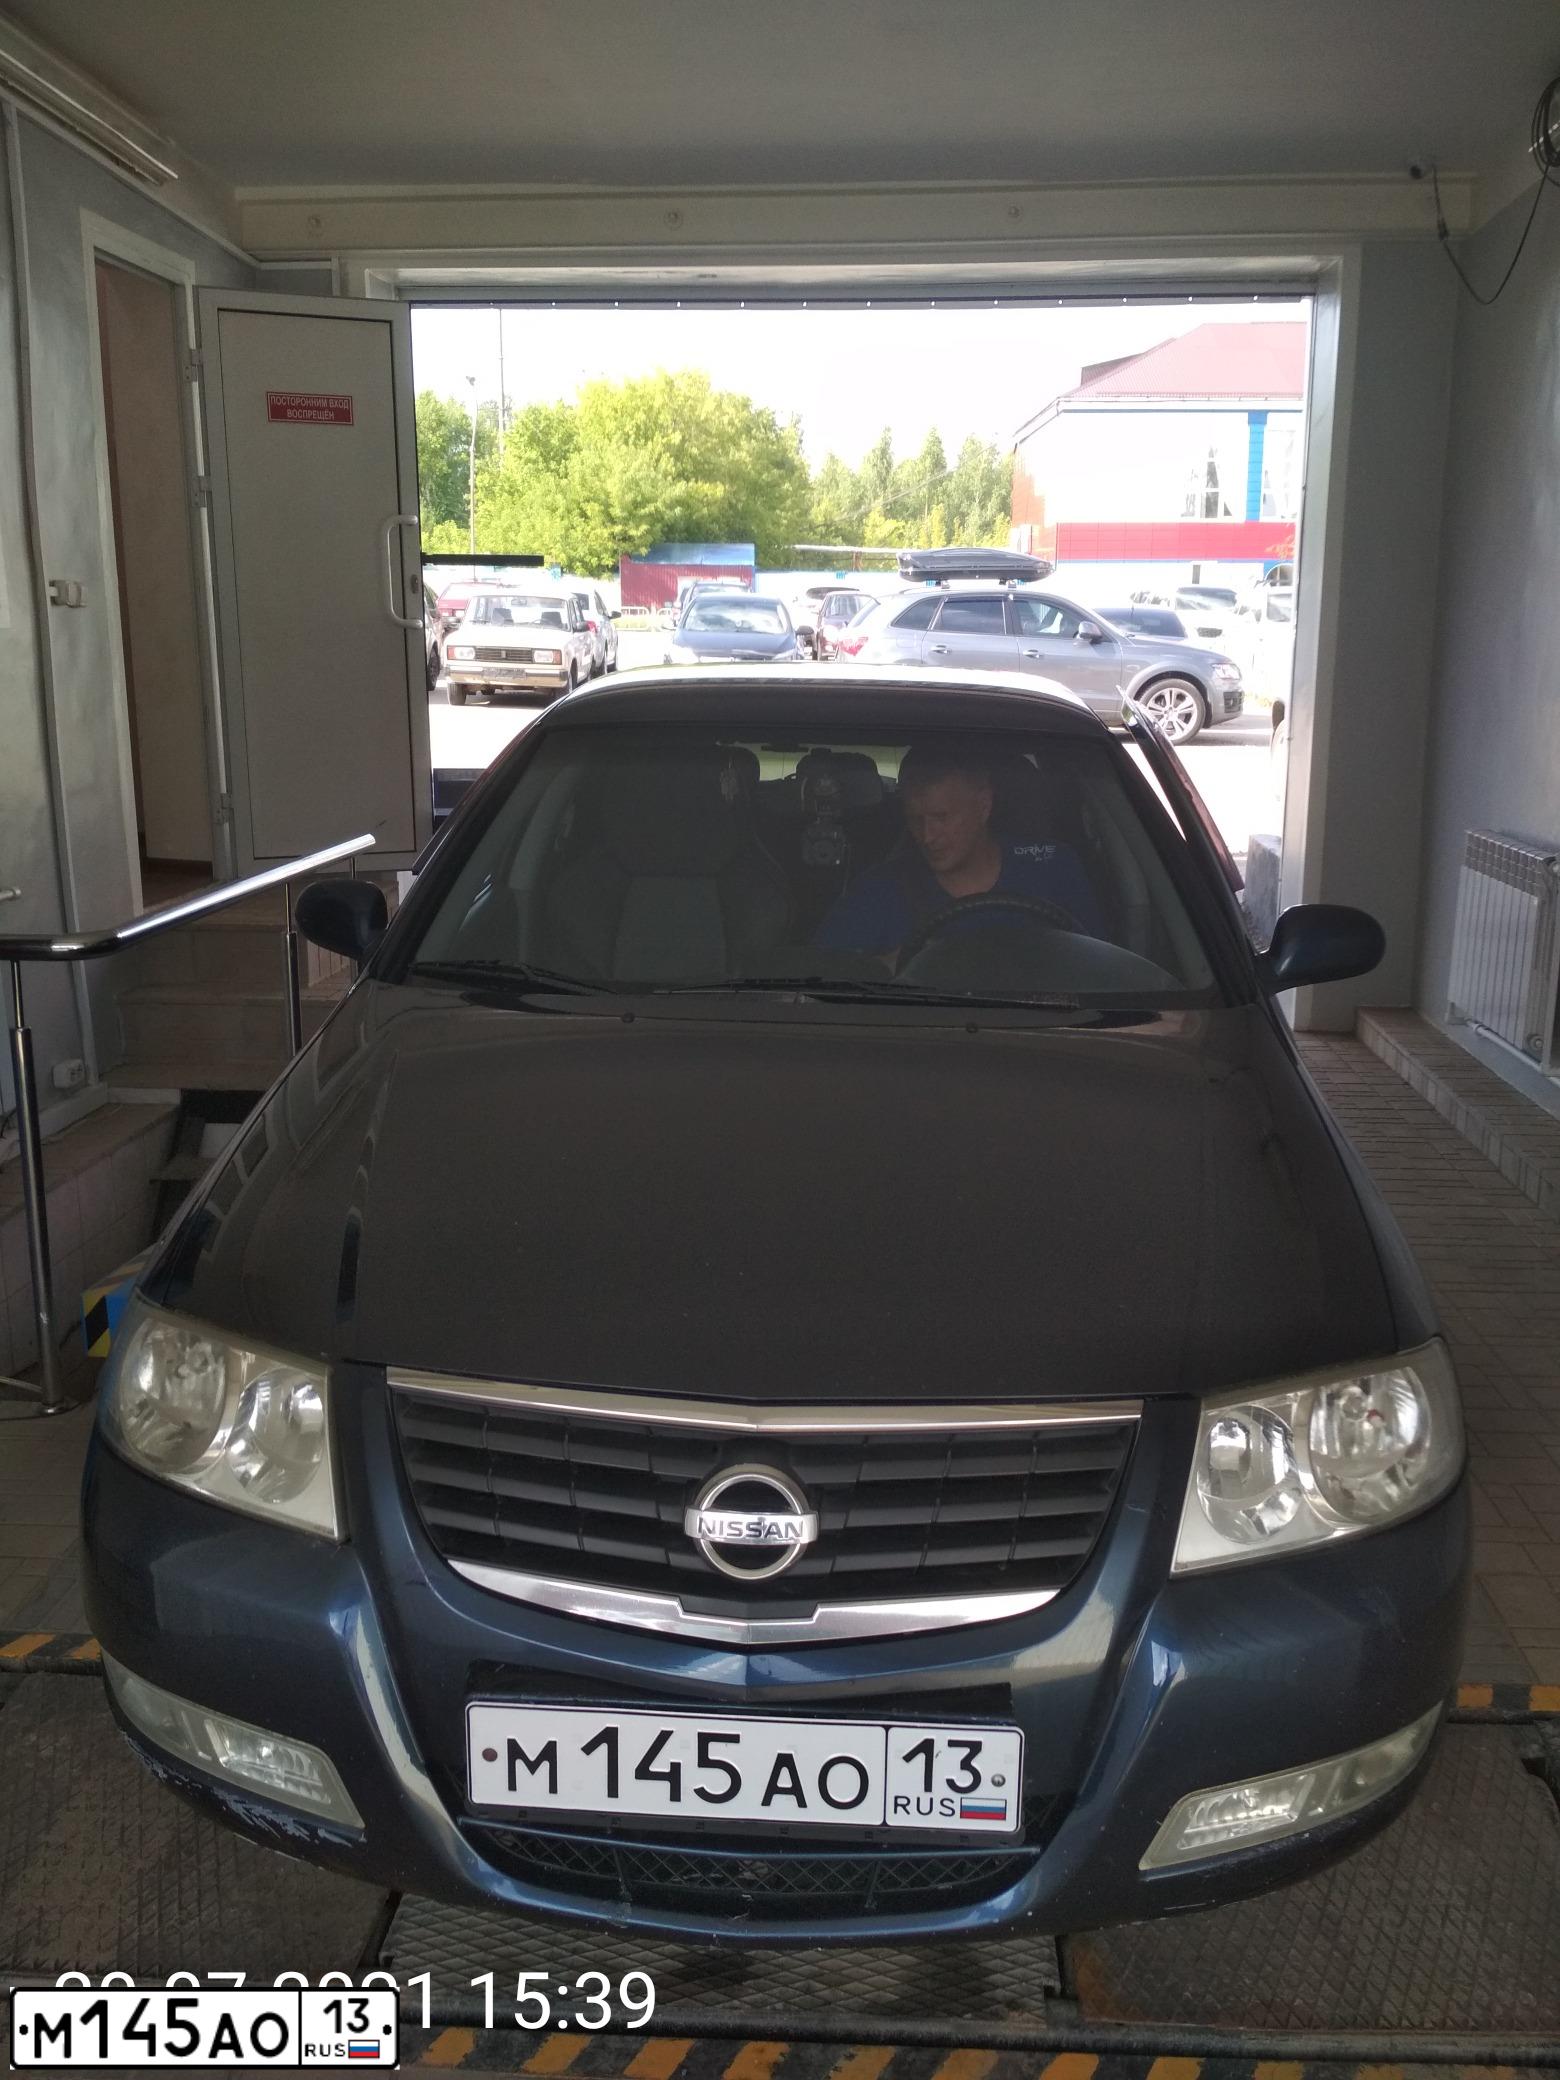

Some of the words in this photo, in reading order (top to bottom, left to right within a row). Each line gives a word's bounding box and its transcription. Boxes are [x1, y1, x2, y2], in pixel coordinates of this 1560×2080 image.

[270, 395, 328, 408] ПОСТОРОННИМ
[329, 398, 349, 410] ВХОД
[697, 1515, 804, 1539] NISSAN
[902, 1737, 983, 1795] 13
[893, 1795, 956, 1817] RUS
